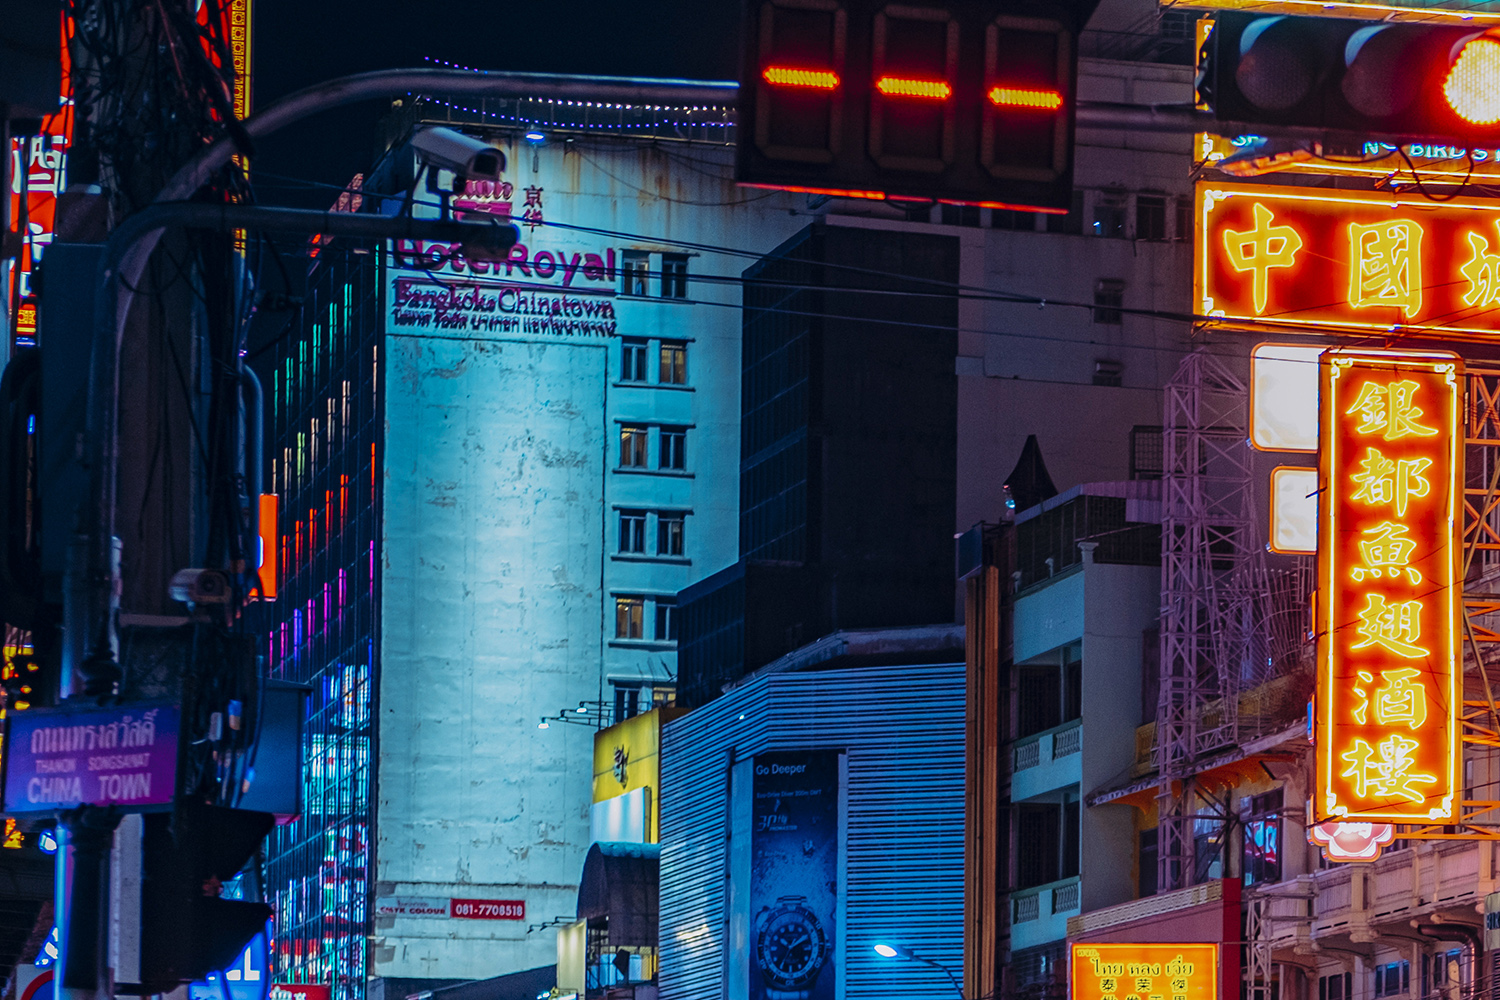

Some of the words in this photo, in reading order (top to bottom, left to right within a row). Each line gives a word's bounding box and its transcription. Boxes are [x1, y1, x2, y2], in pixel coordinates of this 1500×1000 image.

[508, 243, 616, 287] Royal
[1340, 380, 1439, 804] 銀都魚翅酒樓
[755, 765, 770, 775] Go
[772, 764, 806, 776] Deeper
[27, 776, 83, 803] CHINA
[98, 773, 152, 800] TOWN
[409, 907, 446, 915] COLOUR
[455, 903, 523, 917] 081-7708518
[1091, 957, 1123, 976] ไทย
